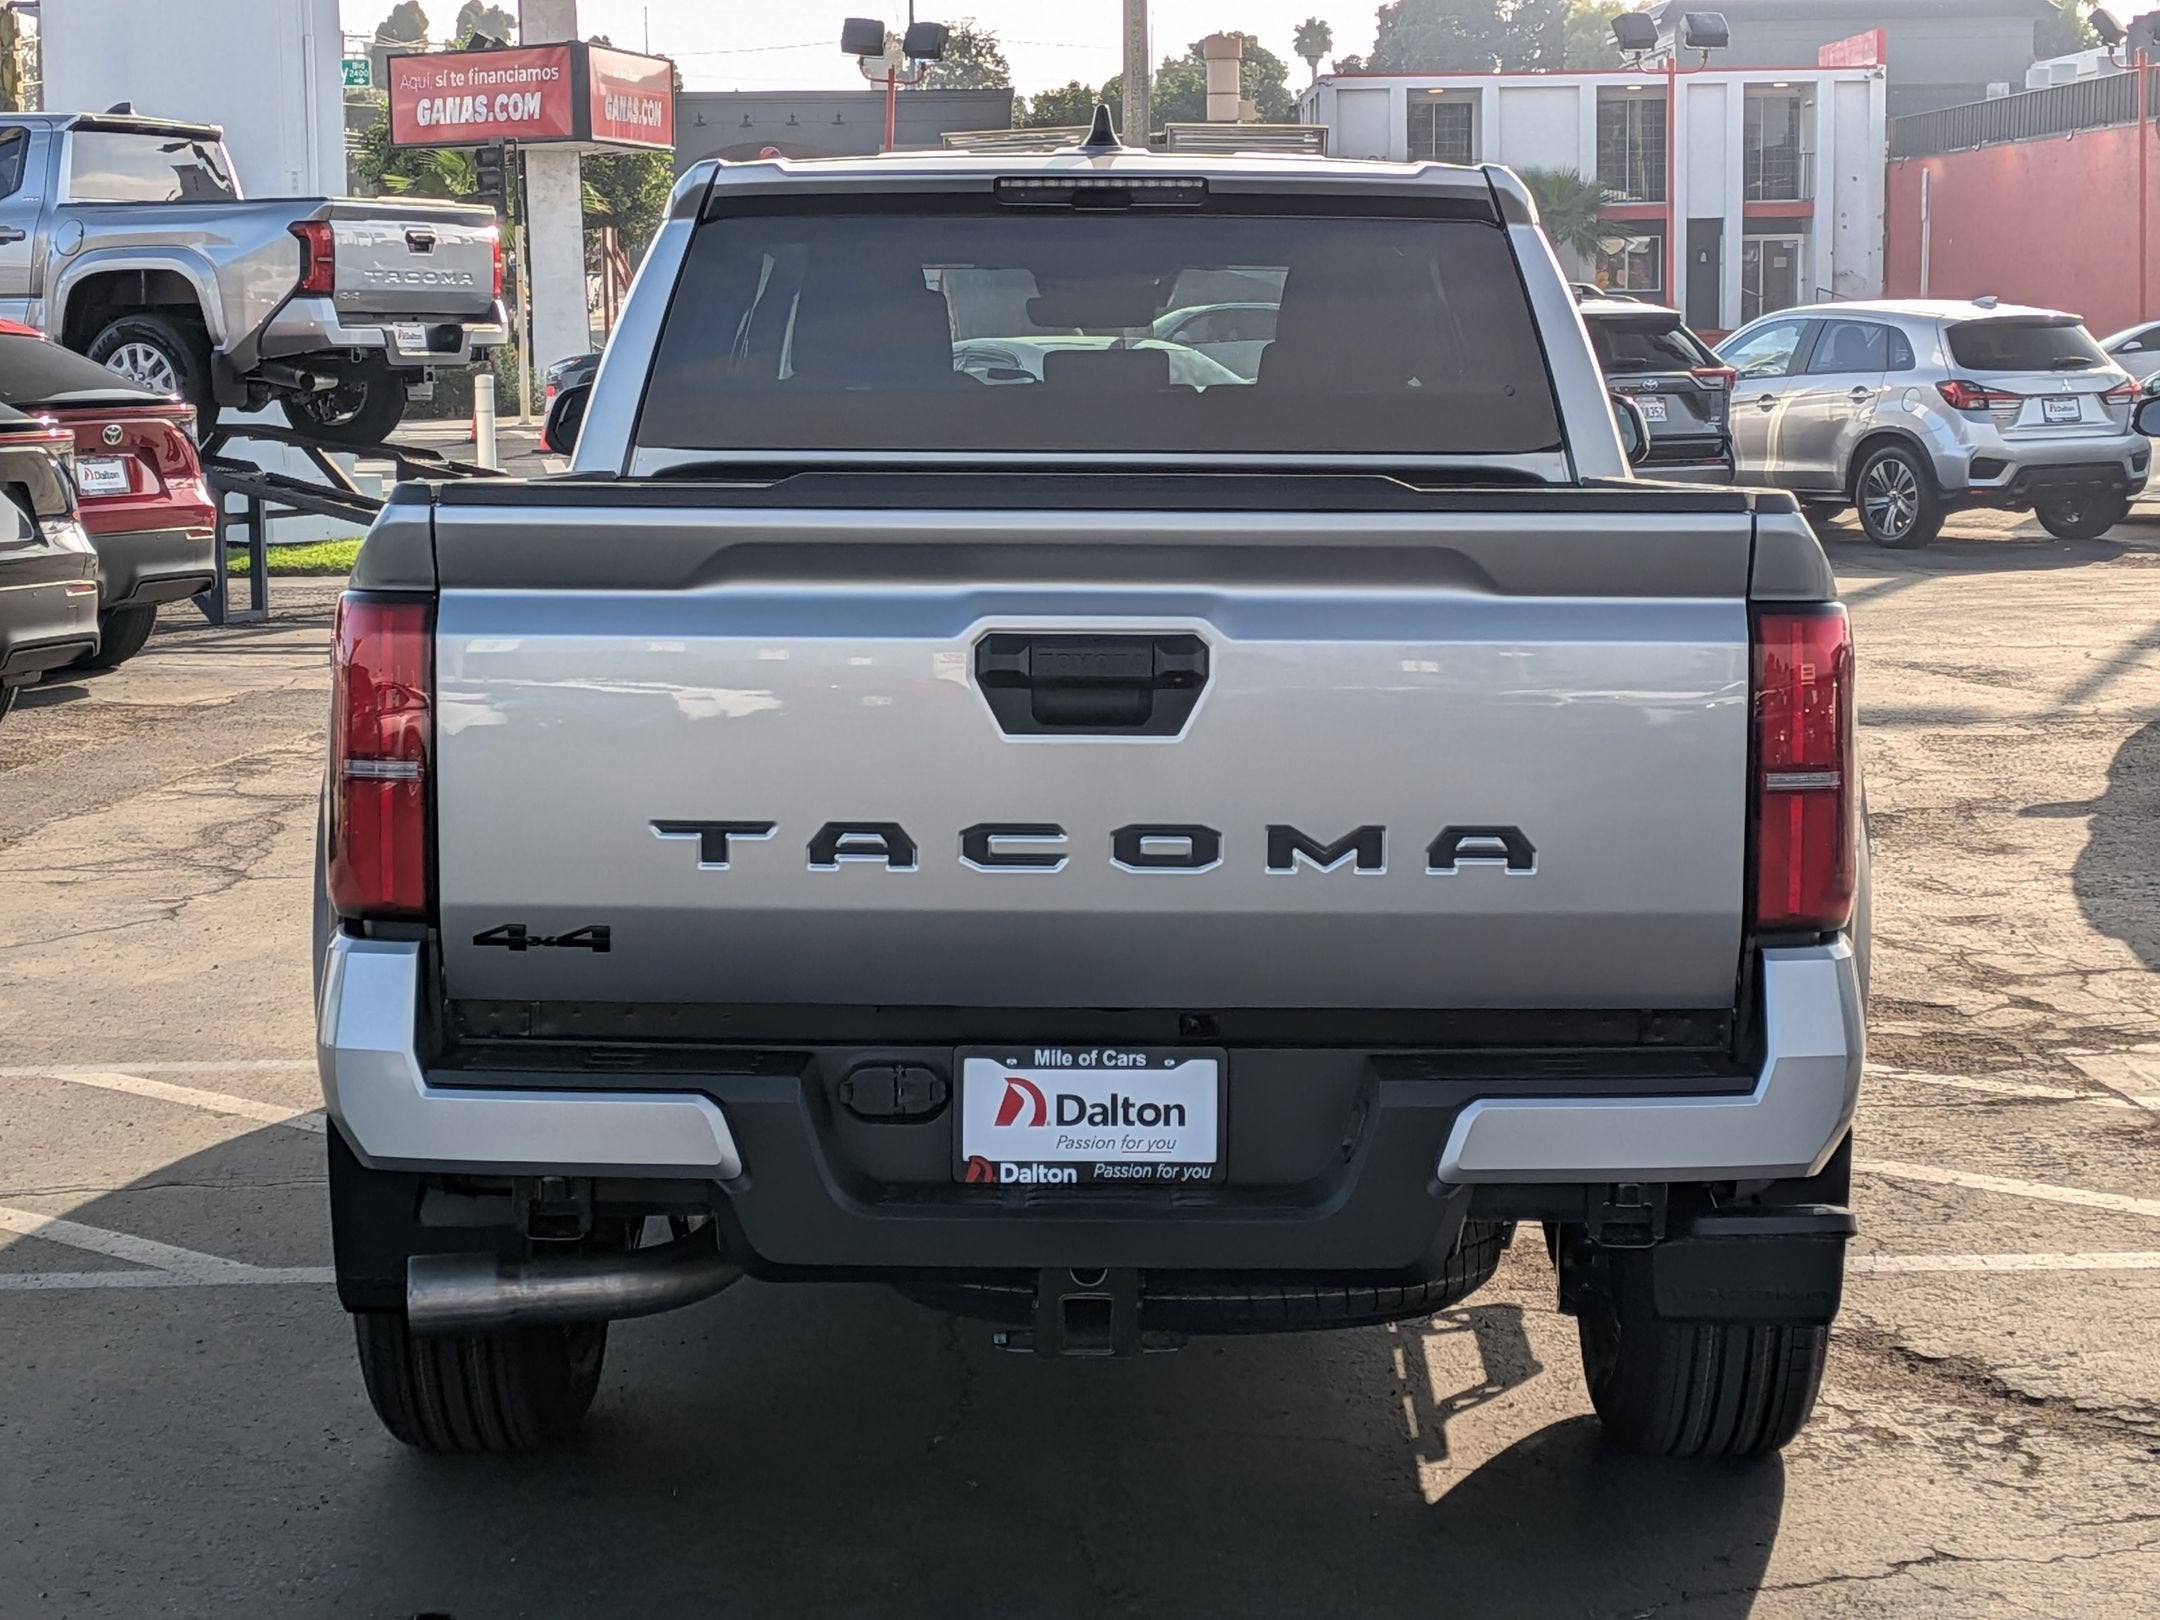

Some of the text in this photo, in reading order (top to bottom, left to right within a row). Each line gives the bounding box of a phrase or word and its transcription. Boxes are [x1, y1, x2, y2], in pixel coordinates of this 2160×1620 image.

[435, 70, 447, 87] sí
[450, 72, 465, 85] te
[468, 65, 559, 85] financiamos
[417, 92, 541, 127] GANAS.COM
[605, 94, 662, 128] GANAS.COM
[364, 271, 474, 286] TACOMA
[94, 471, 120, 480] Dalton
[650, 820, 1539, 877] TACOMA
[472, 923, 611, 952] 4x4
[1034, 1050, 1147, 1066] Mile of Cars
[1056, 1093, 1186, 1127] Dalton
[1056, 1135, 1177, 1153] Passion for you
[1000, 1163, 1213, 1184] Dalton Passion for you
